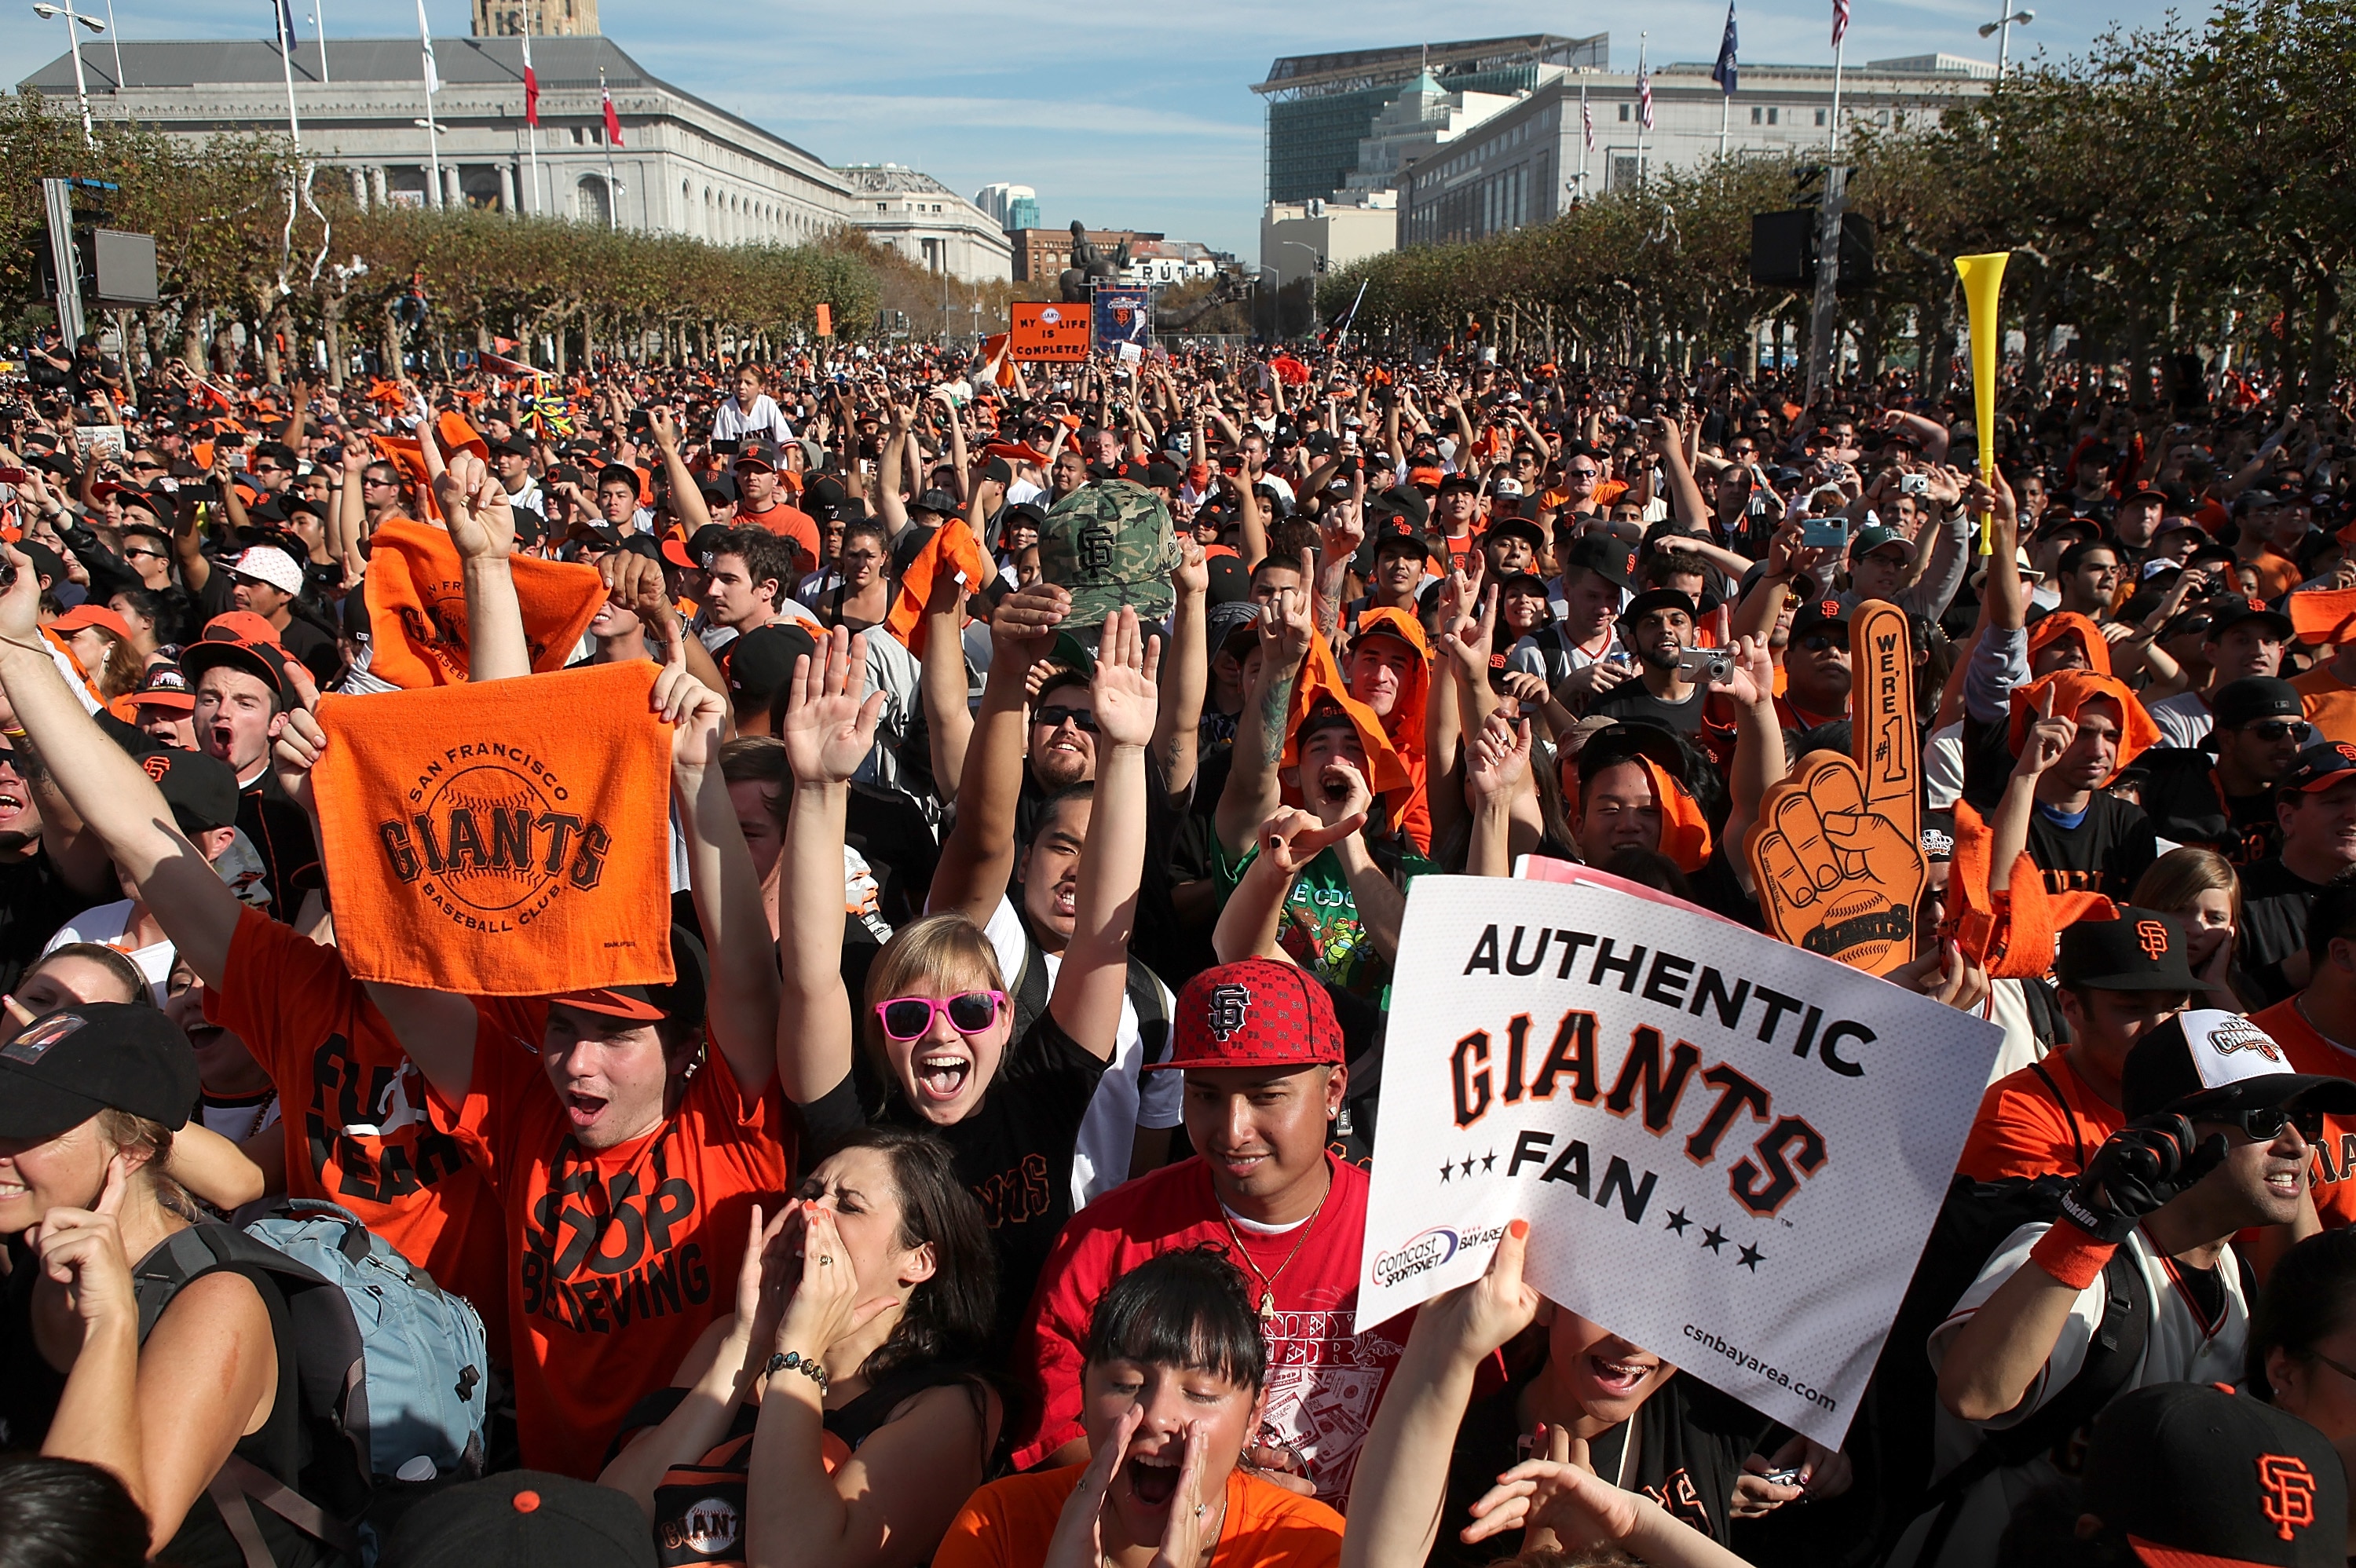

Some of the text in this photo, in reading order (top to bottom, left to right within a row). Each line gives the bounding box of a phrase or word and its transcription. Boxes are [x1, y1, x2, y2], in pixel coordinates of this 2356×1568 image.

[1129, 265, 1205, 281] RUTH
[1016, 345, 1085, 356] COMPLETE!
[1020, 319, 1036, 327] MY
[1042, 330, 1055, 338] IS
[409, 742, 569, 803] SAN FRANCISCO
[1875, 715, 1907, 783] #1
[377, 805, 612, 892] GIANTS
[1763, 857, 1772, 874] SPIRIT
[422, 882, 561, 933] BASEBALL CLUB
[1463, 924, 1878, 1076] AUTHENTIC
[1450, 1009, 1828, 1218] GIANTS
[1507, 1130, 1658, 1225] FAN
[527, 1178, 696, 1281] STOP
[1458, 1227, 1503, 1251] BAY ARE
[1385, 1253, 1442, 1288] SPORTSNET
[1683, 1324, 1837, 1413] csnbayarea.com
